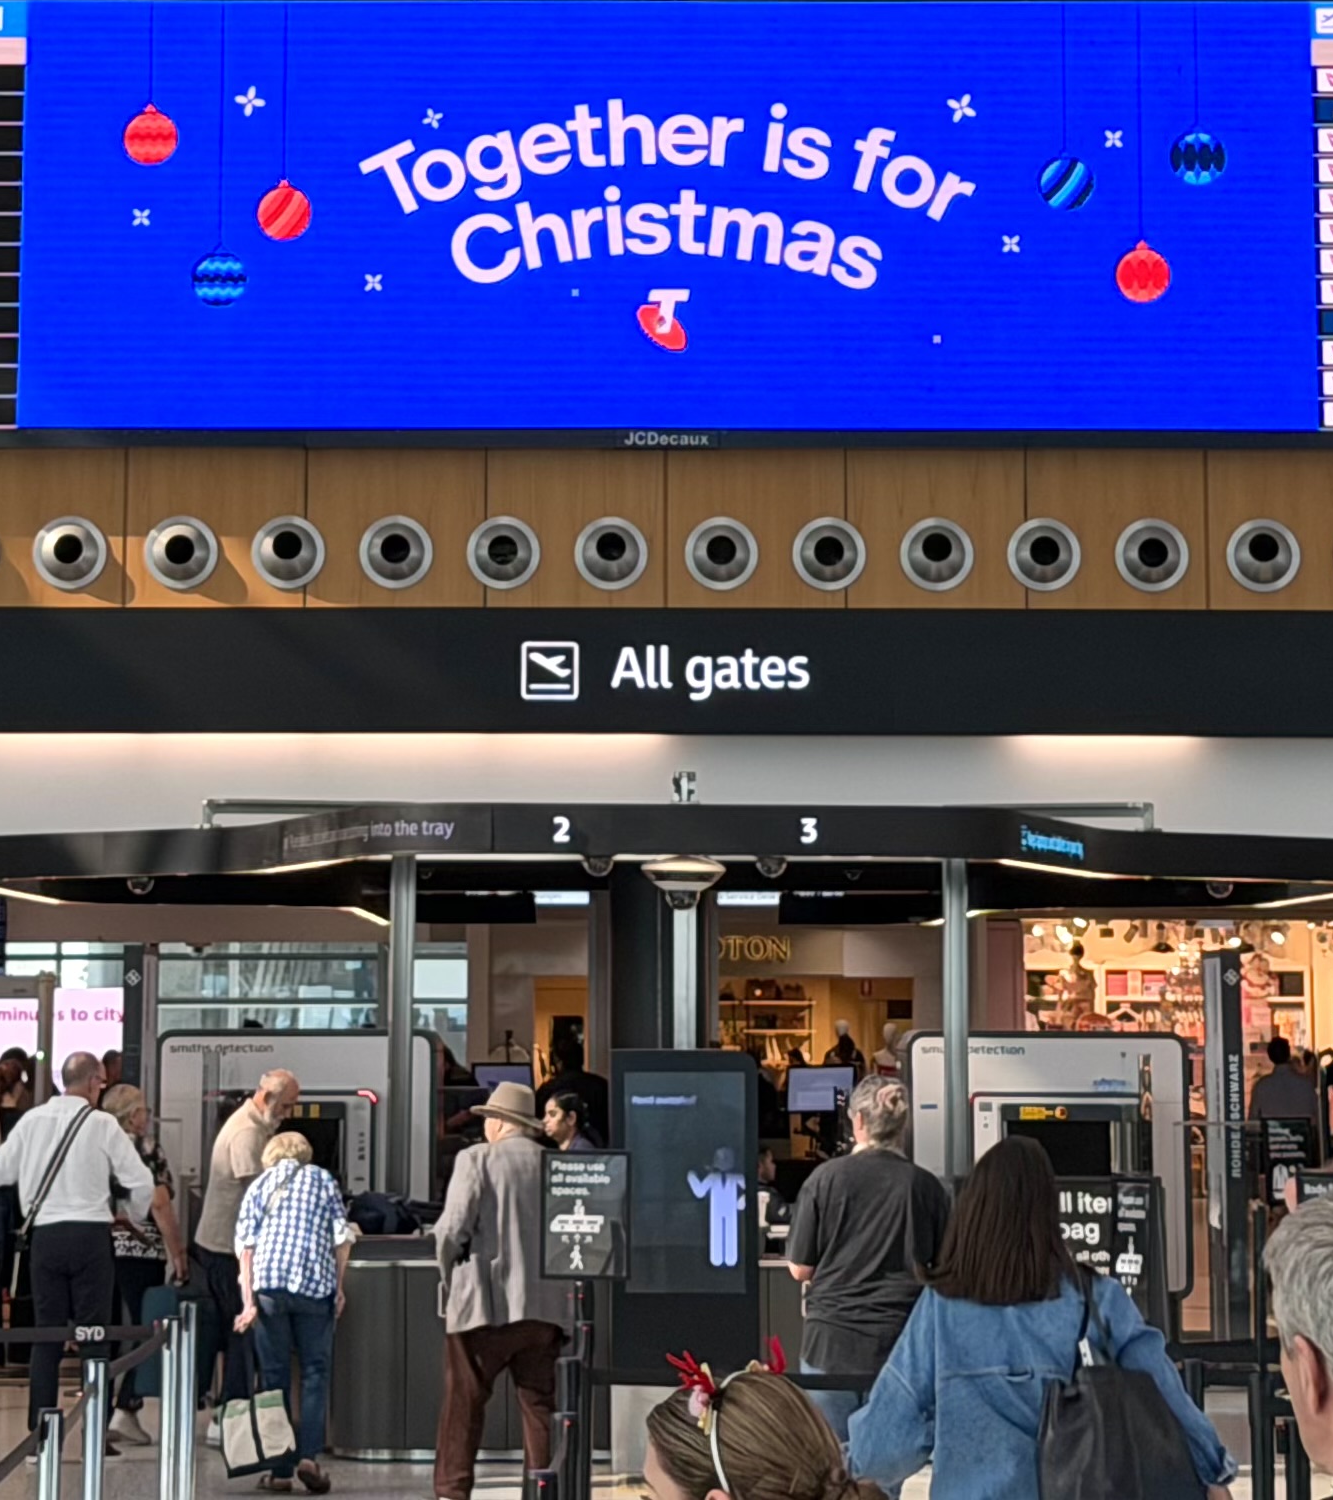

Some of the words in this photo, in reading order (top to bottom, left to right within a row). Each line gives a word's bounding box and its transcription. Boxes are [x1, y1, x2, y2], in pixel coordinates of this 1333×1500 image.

[358, 98, 745, 215] Together
[762, 102, 833, 181] is
[852, 127, 976, 222] for
[450, 185, 883, 290] Christmas
[624, 432, 709, 447] JCDecaux
[611, 644, 673, 688] All
[685, 648, 810, 701] gates
[552, 816, 570, 842] 2
[800, 817, 818, 843] 3
[75, 1325, 105, 1342] SYD
